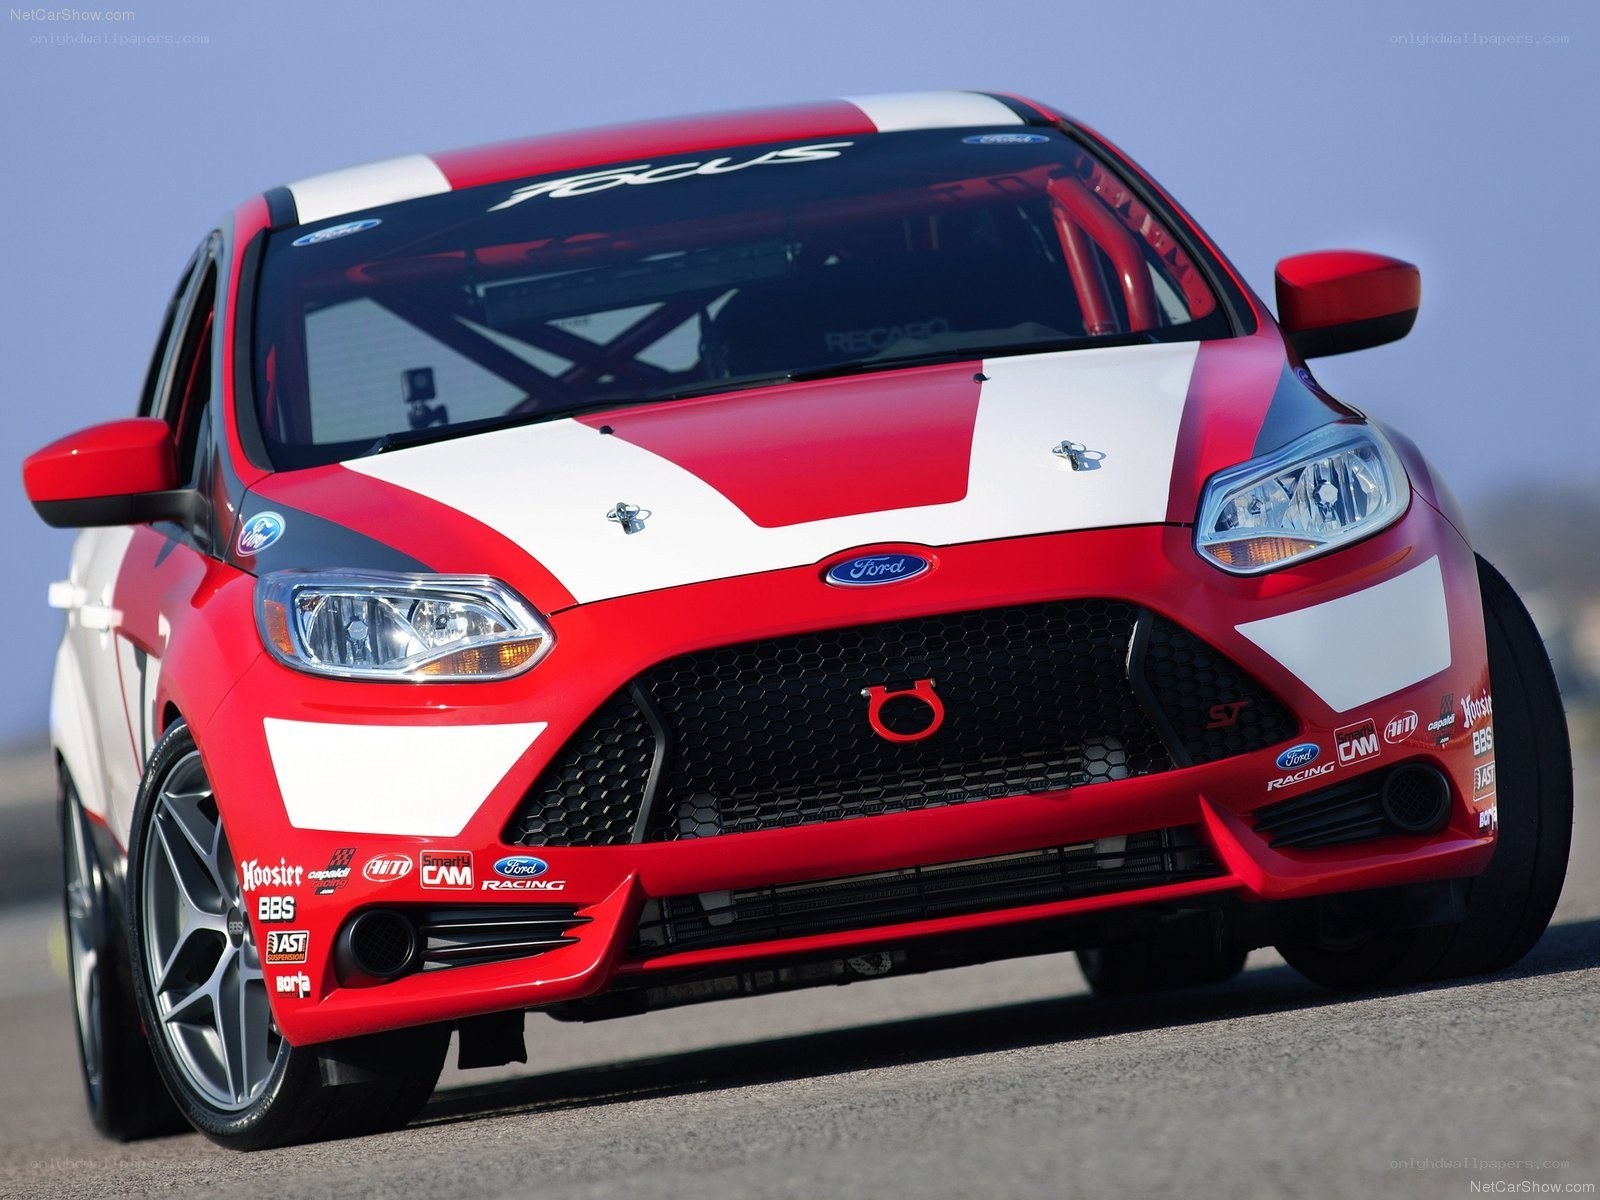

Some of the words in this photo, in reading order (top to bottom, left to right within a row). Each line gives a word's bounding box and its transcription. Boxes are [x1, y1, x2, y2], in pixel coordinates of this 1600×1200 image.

[825, 318, 949, 352] RECARO
[241, 517, 275, 549] Ford
[849, 556, 905, 579] Ford
[1206, 701, 1249, 729] ST
[1338, 733, 1379, 762] CAM
[1472, 726, 1493, 756] BBS
[1266, 761, 1335, 792] RACING
[423, 855, 470, 867] Smarty
[241, 857, 303, 892] Hoosier
[307, 867, 351, 881] capaldi
[422, 866, 472, 886] CAM
[481, 880, 566, 891] RACING
[259, 896, 295, 921] BBS
[278, 934, 307, 953] AST
[267, 952, 305, 961] SUSPENSION
